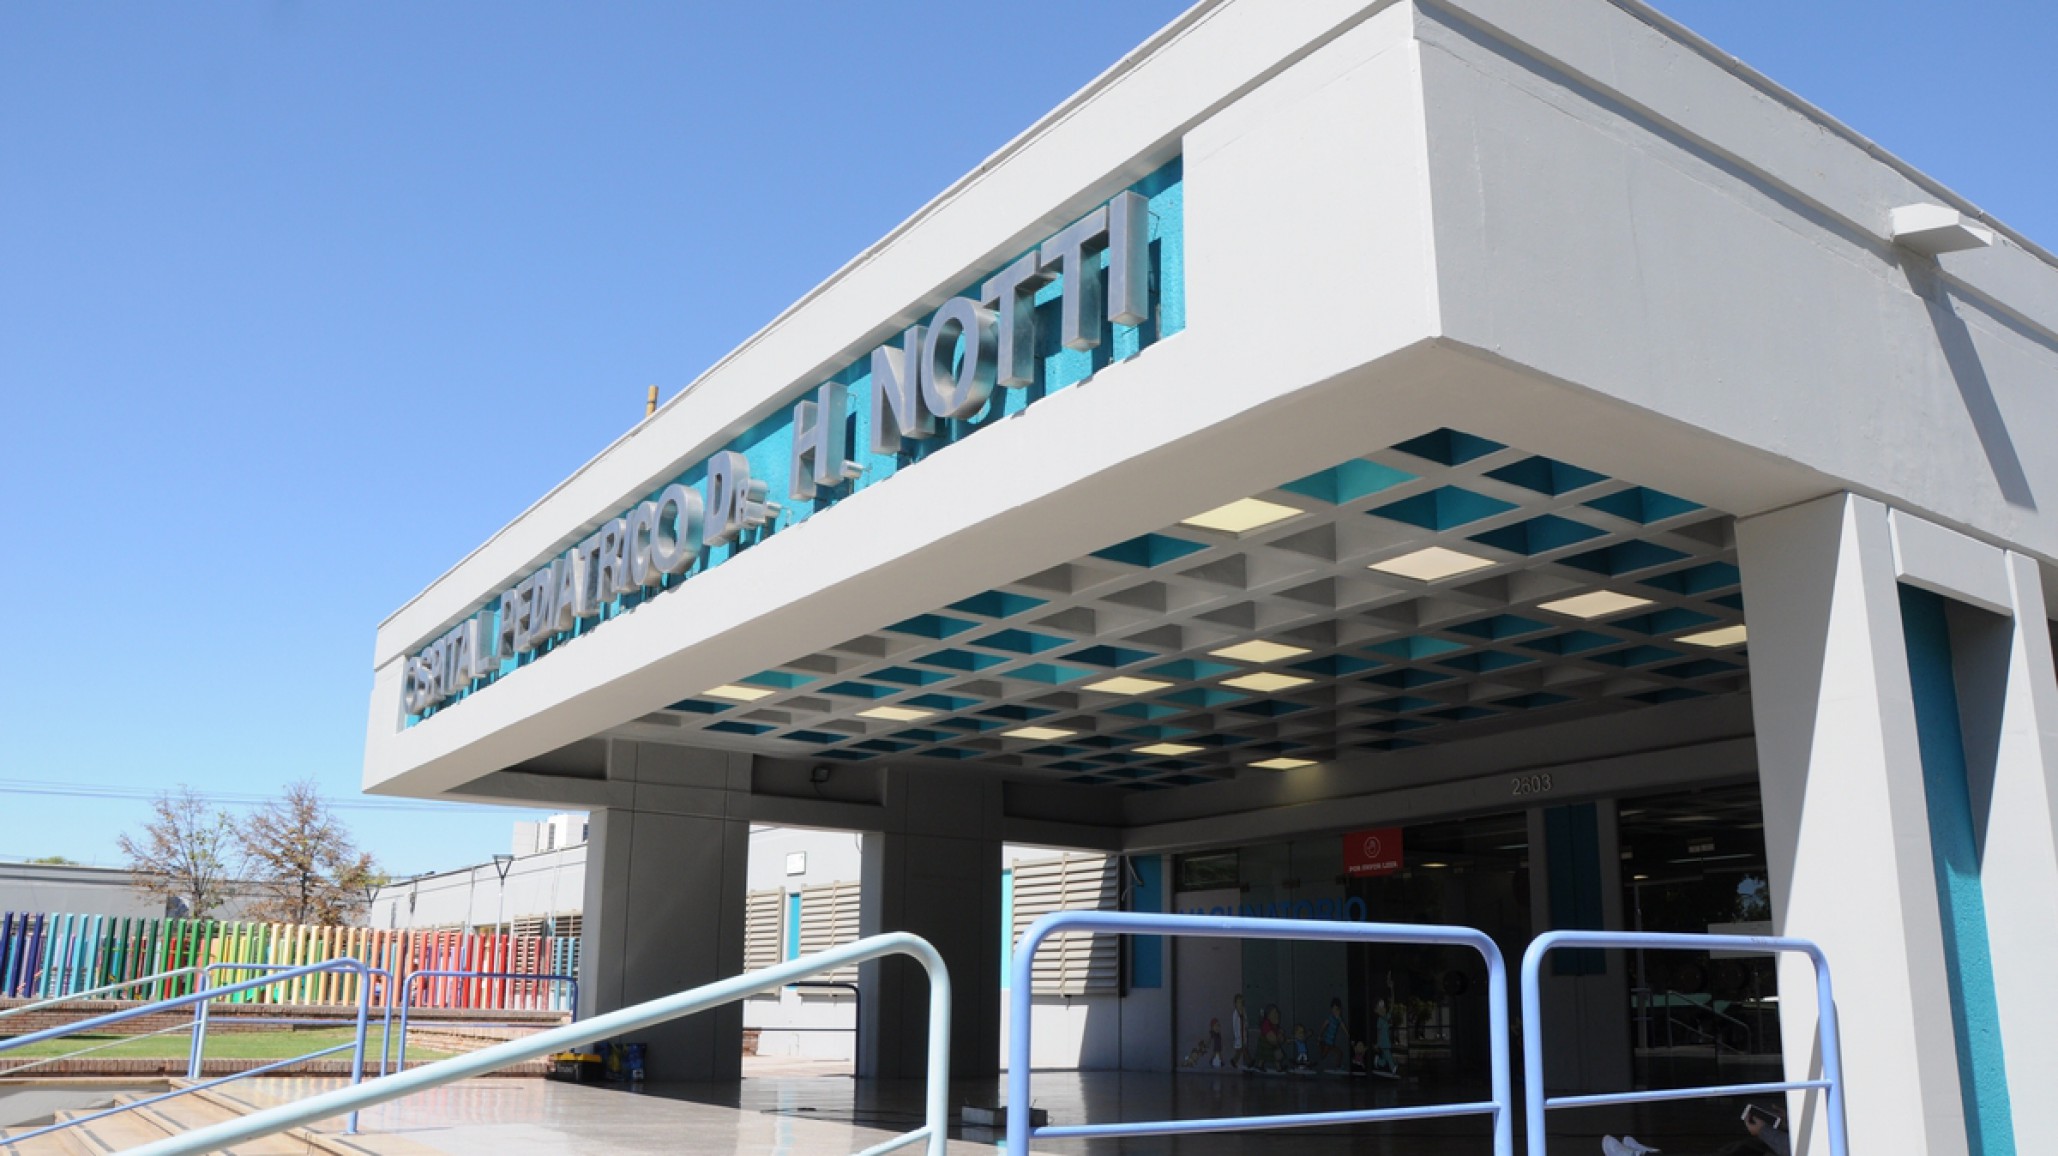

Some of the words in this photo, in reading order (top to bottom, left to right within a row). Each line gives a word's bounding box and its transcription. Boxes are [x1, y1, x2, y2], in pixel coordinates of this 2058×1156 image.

[404, 609, 500, 715] OSPITAL
[500, 483, 704, 661] PEDIATRICO
[870, 189, 1149, 455] NOTTI
[1512, 773, 1552, 796] 2603
